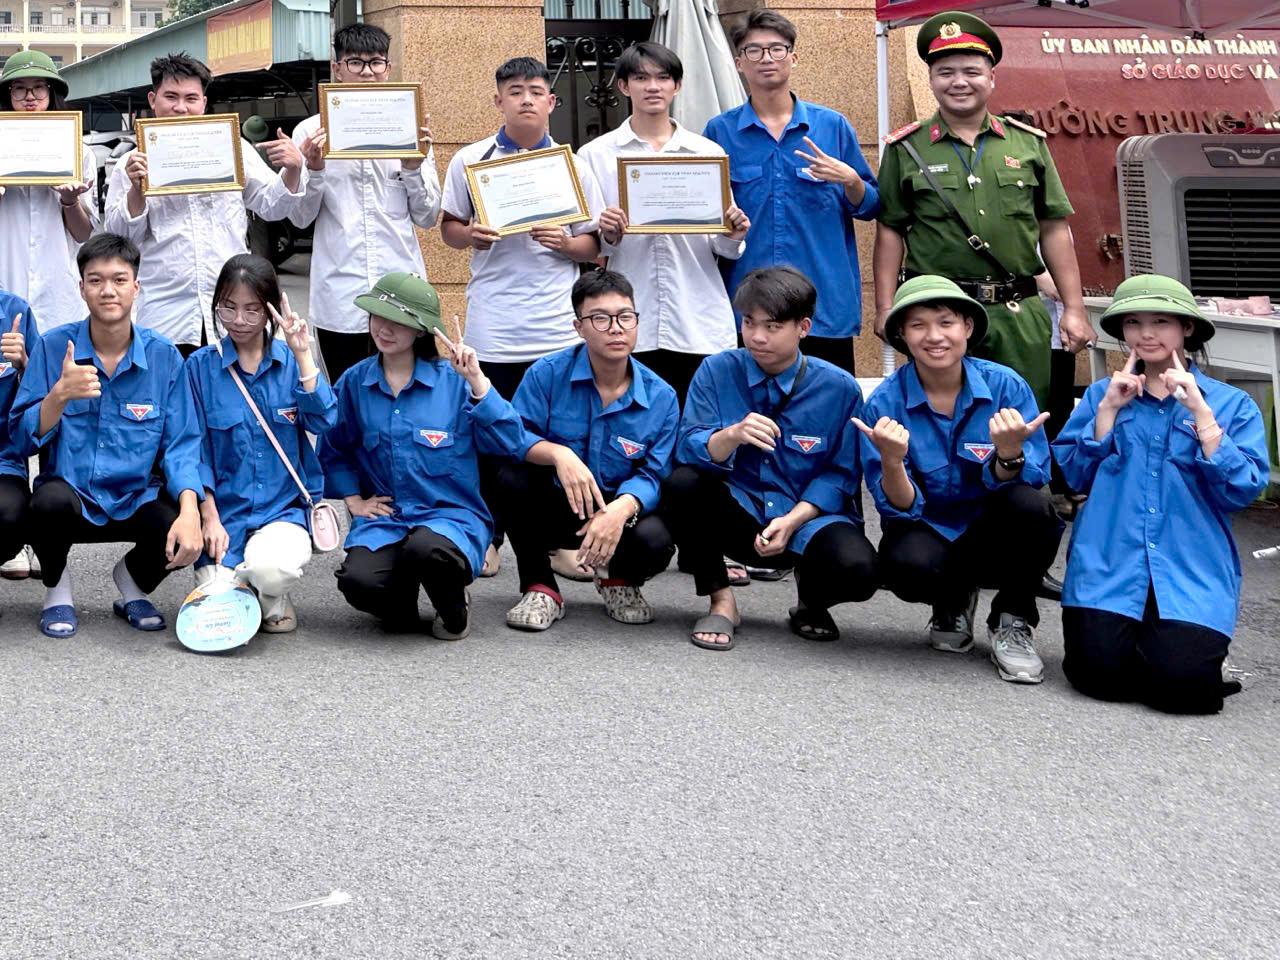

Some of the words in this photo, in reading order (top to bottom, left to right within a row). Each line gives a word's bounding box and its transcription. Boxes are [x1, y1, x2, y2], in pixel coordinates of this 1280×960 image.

[1041, 30, 1065, 54] ỦY
[1070, 38, 1111, 54] BAN
[1112, 33, 1168, 55] NHÂN
[1214, 33, 1278, 55] THÀNH
[1121, 57, 1149, 80] SỞ
[1151, 57, 1202, 80] GIÁO
[1204, 63, 1246, 84] DỤC
[1248, 58, 1279, 80] VÀ
[1024, 98, 1129, 135] ƯỜNG
